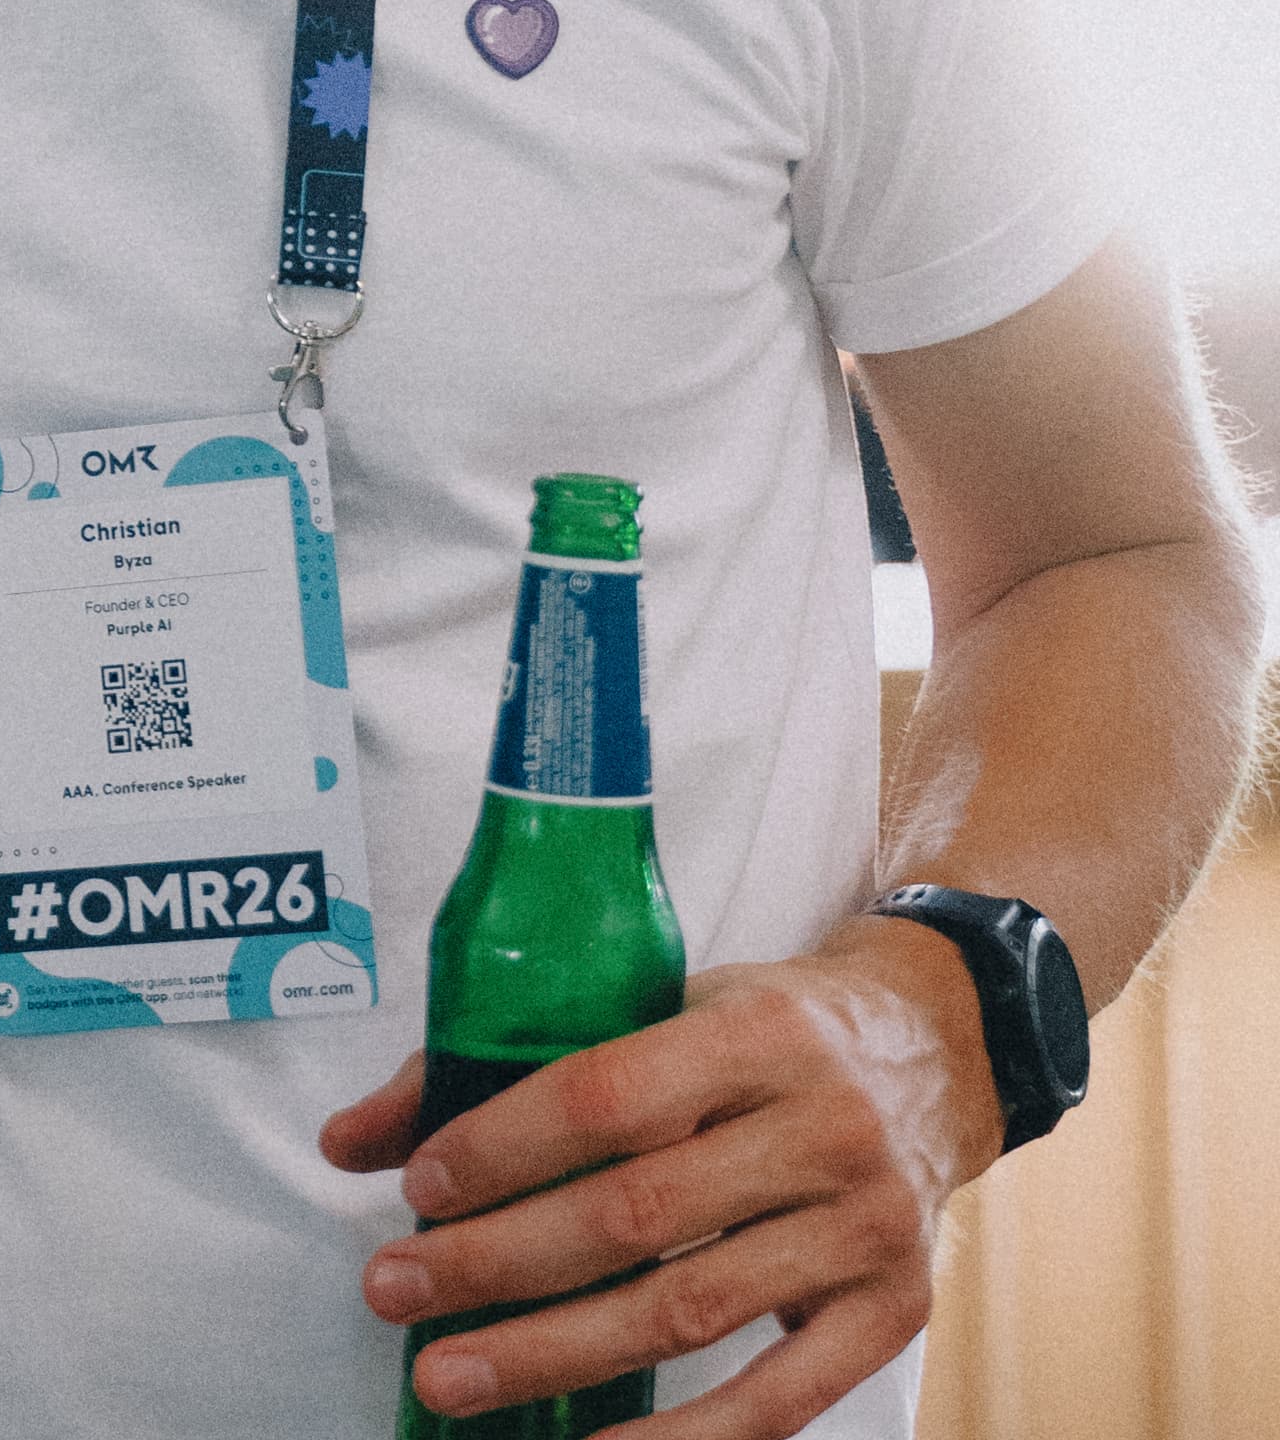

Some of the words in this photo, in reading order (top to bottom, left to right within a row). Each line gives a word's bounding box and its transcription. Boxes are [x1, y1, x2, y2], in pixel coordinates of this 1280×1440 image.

[80, 518, 181, 543] Christian
[114, 555, 153, 571] Byza
[85, 596, 140, 614] Founder
[145, 596, 155, 609] &
[157, 592, 190, 608] CEO
[107, 621, 154, 637] Purple
[157, 618, 172, 632] AI
[103, 780, 184, 796] Conference
[187, 773, 247, 790] Speaker
[8, 863, 316, 942] #OMR26
[189, 975, 215, 985] scan
[283, 982, 353, 998] omr.com
